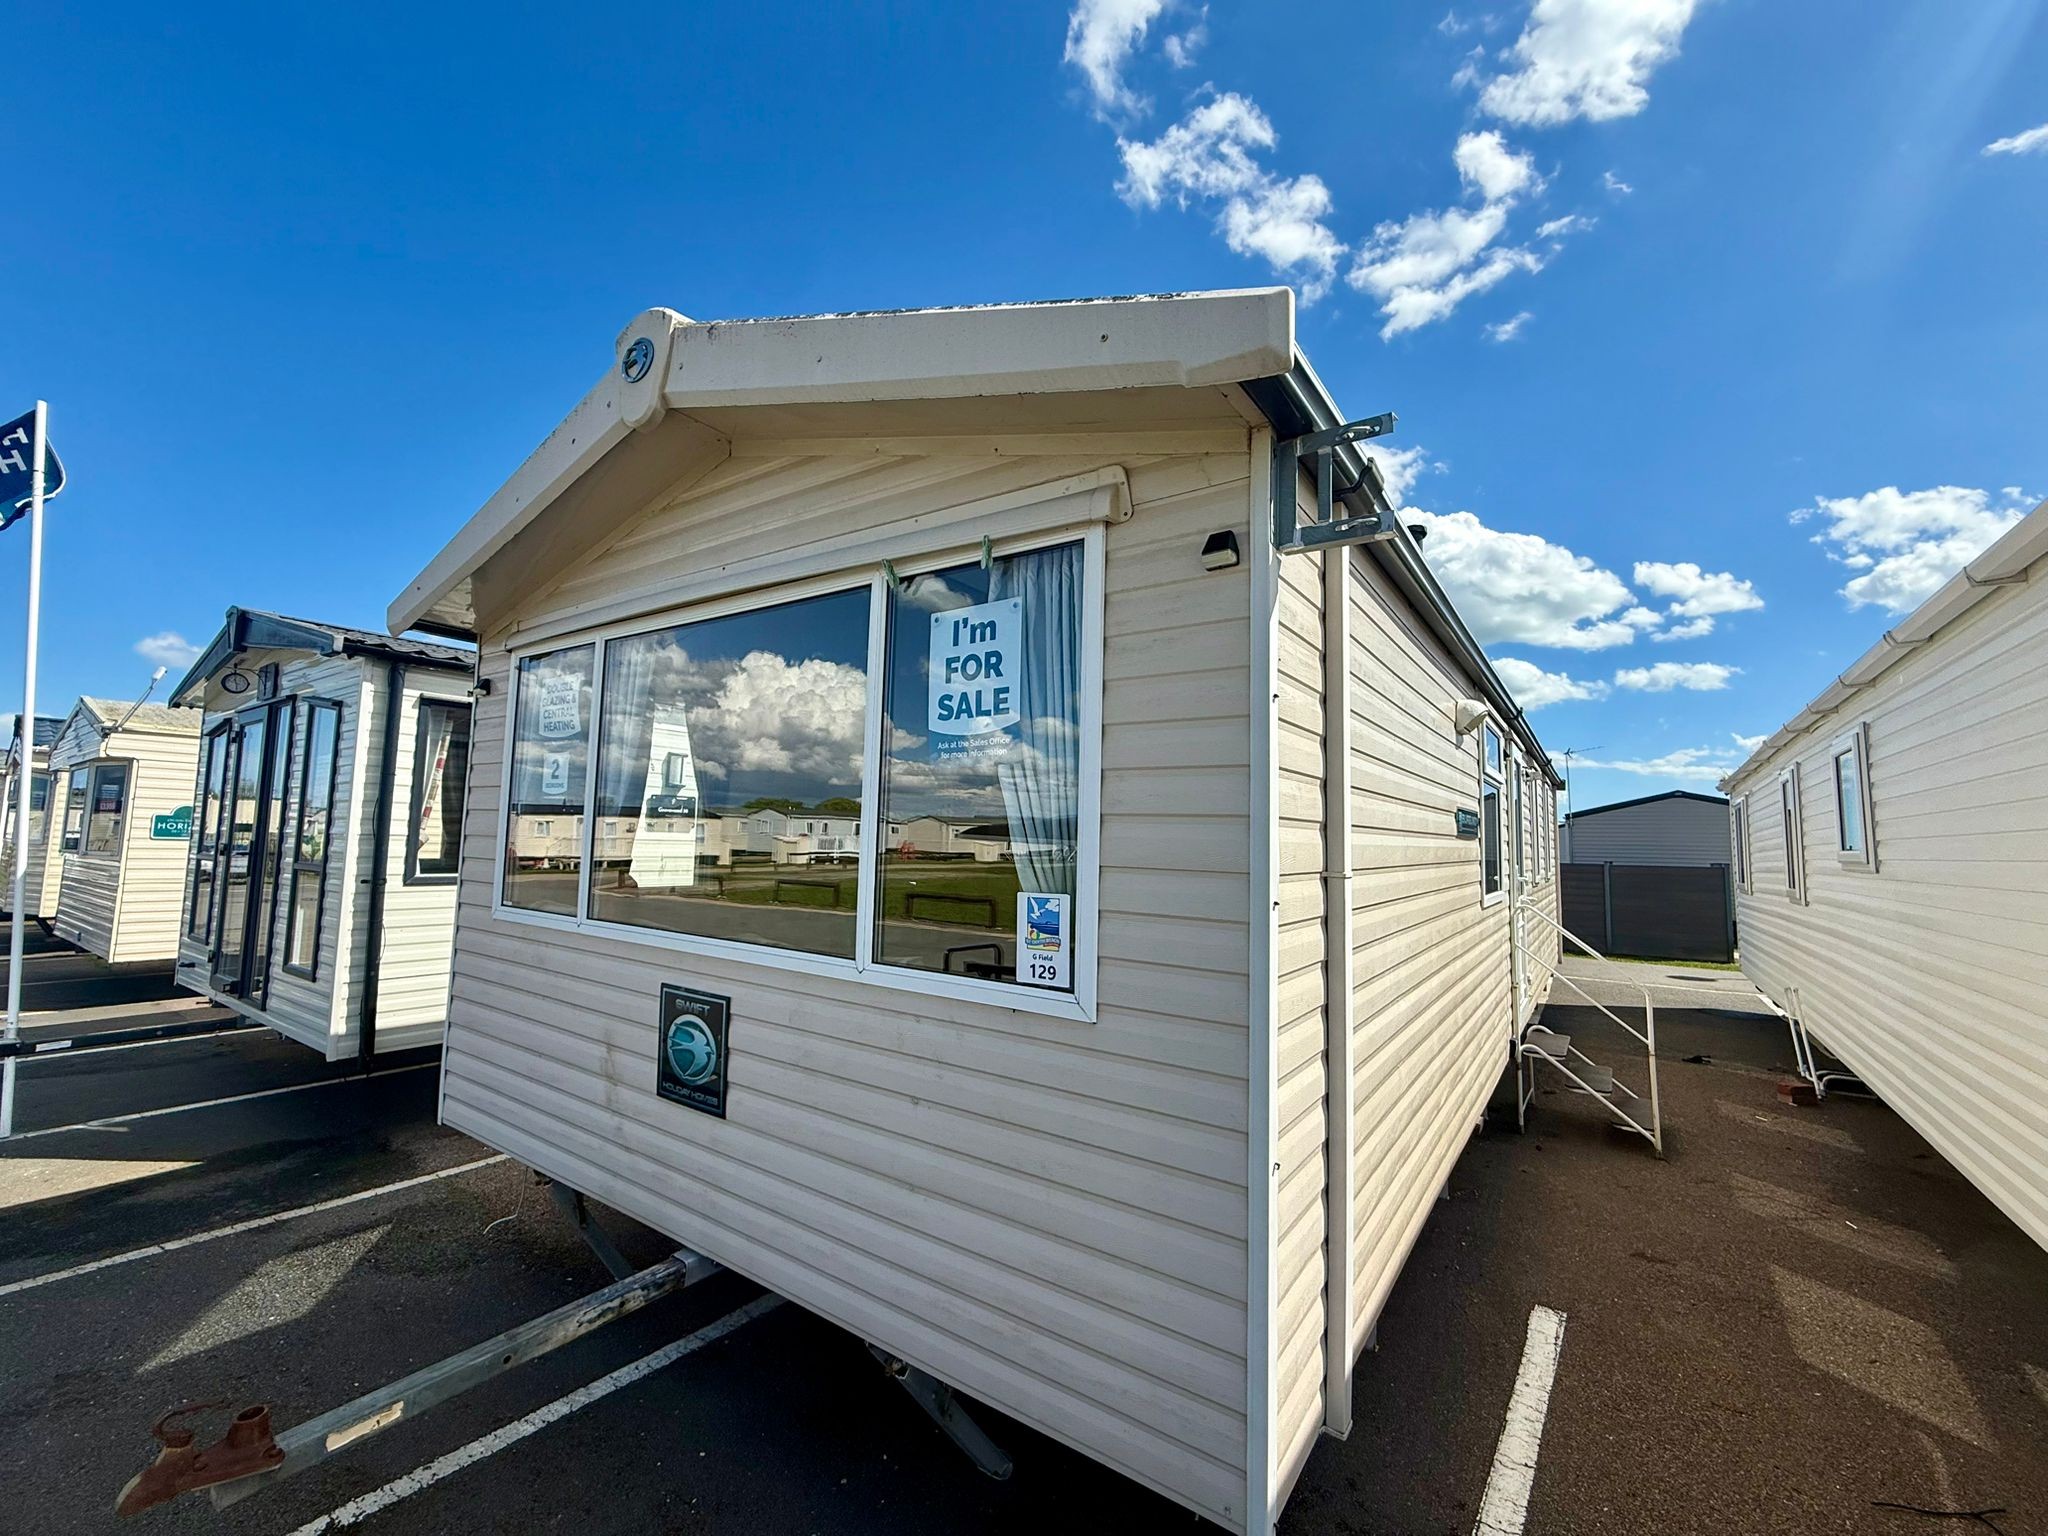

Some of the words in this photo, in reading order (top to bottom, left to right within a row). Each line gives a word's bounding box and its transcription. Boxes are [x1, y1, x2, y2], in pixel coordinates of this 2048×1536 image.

[952, 616, 997, 647] I'm
[945, 650, 1004, 684] FOR
[937, 686, 1010, 722] SALE
[543, 719, 576, 732] HEATING
[937, 741, 950, 750] Ask
[957, 740, 969, 748] the
[970, 739, 988, 747] Sales
[989, 736, 1010, 745] Office
[941, 751, 950, 759] for
[551, 759, 560, 780] 2
[1038, 953, 1053, 961] Field
[1029, 963, 1057, 981] 129
[675, 998, 711, 1016] SWIFT
[663, 1080, 691, 1097] HOLIDAY
